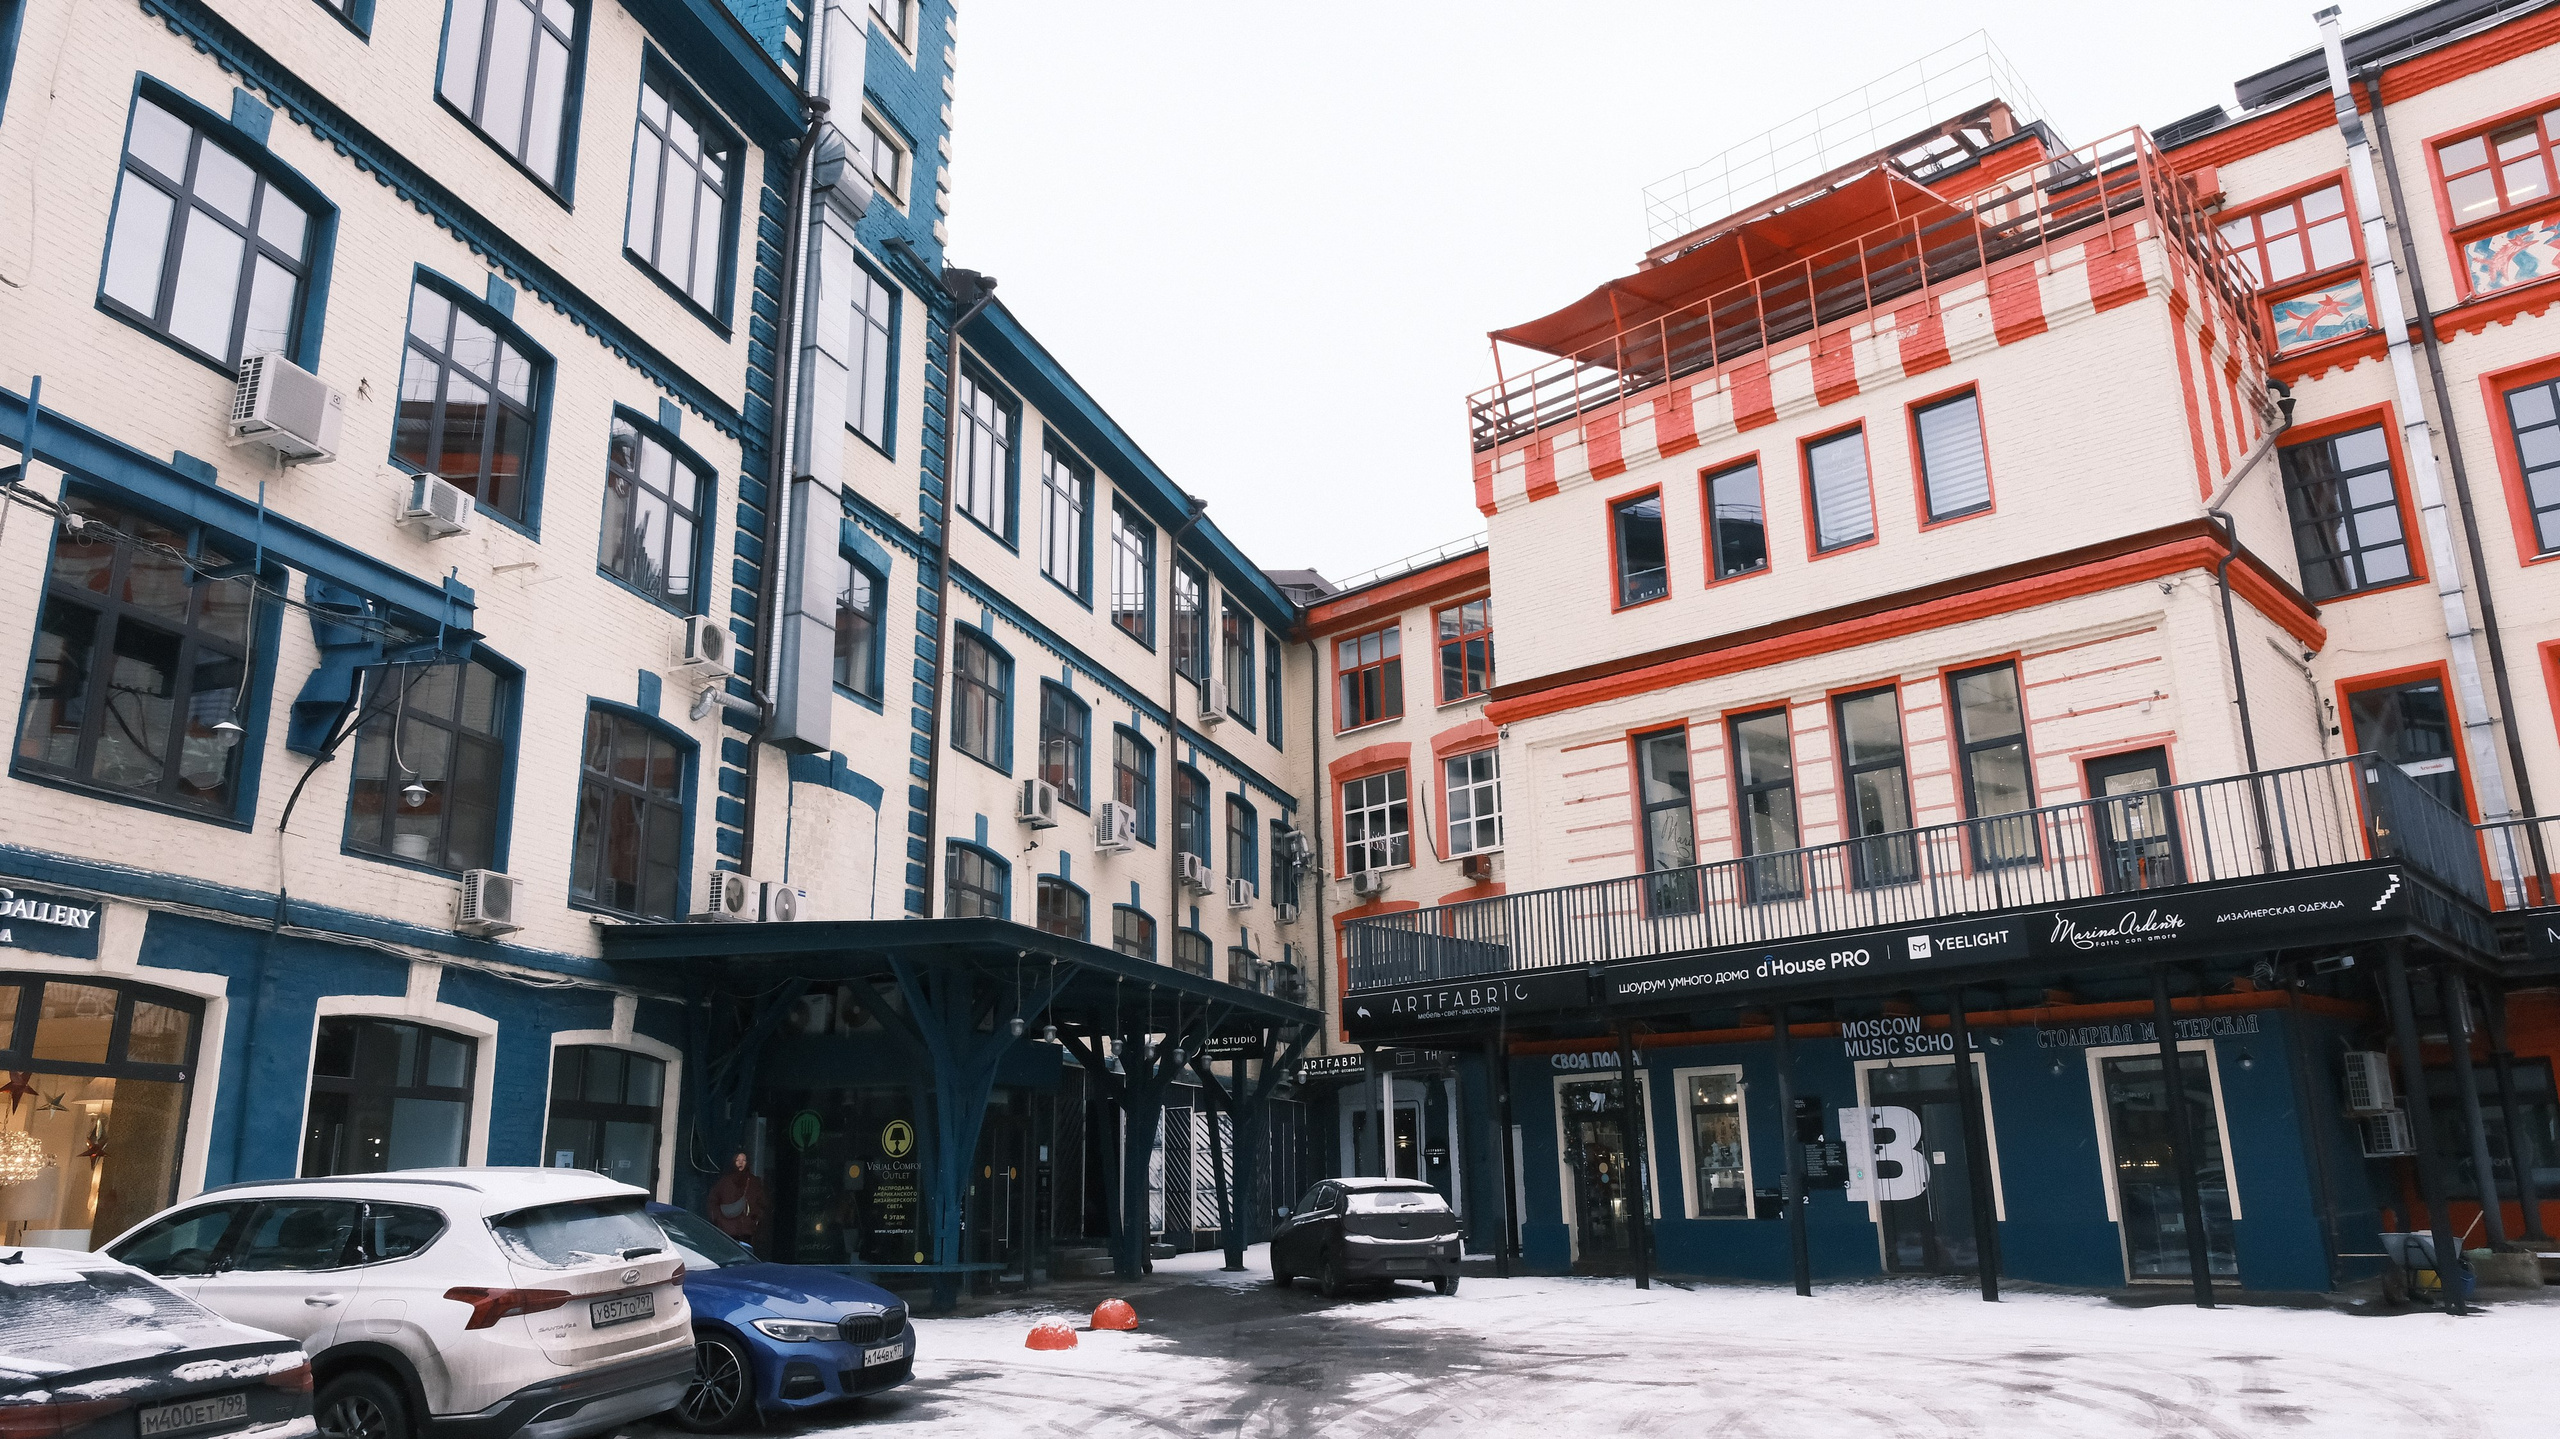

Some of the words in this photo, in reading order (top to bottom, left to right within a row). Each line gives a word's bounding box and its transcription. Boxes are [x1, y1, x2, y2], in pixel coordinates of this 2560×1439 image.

[0, 887, 96, 929] GALLERY
[2216, 905, 2295, 923] ДИЗАЙНЕРСКАЯ
[2298, 900, 2344, 914] ОДЕЖДА
[2050, 912, 2119, 950] Marina
[2118, 909, 2186, 936] Ardente
[2147, 933, 2177, 941] amore
[1935, 930, 2010, 951] YEELIGHT
[1618, 977, 1666, 994] шоурум
[1667, 973, 1712, 991] умного
[1715, 968, 1750, 985] дома
[1830, 949, 1870, 969] PRO
[1841, 1016, 1921, 1039] MOSCOW
[2036, 1023, 2133, 1049] СТОЛЯРНАЯ
[2139, 1014, 2260, 1041] МТЕРСКАЯ
[1222, 1036, 1257, 1045] STUDIO
[1844, 1037, 1900, 1058] MUSIC
[1904, 1032, 1979, 1054] SCHOL
[1551, 1052, 1591, 1069] СВОЯ
[1592, 1049, 1643, 1068] ПОЛА
[1818, 1134, 1825, 1143] 4
[866, 1161, 891, 1171] VISUAL
[882, 1170, 910, 1180] OUTLET
[1843, 1180, 1851, 1189] 3
[1803, 1195, 1809, 1204] 2
[220, 1396, 243, 1414] 799
